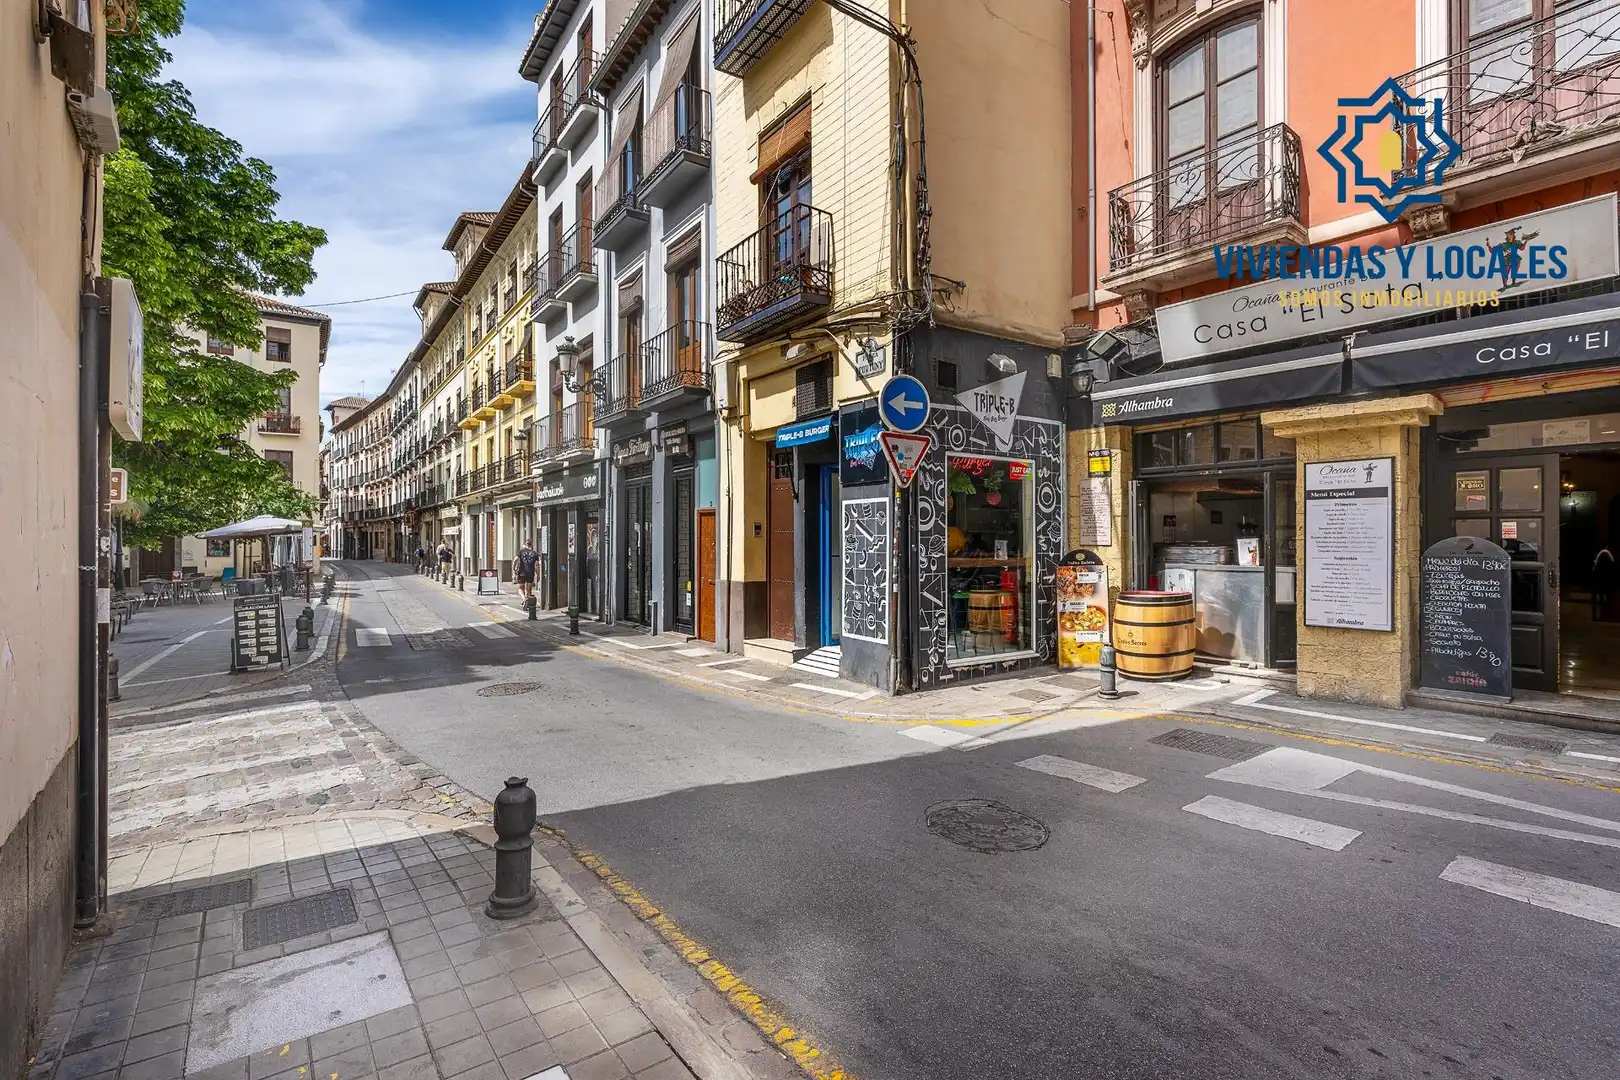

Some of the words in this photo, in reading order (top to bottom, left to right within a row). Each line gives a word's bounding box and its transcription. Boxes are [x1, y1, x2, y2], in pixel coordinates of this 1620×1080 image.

[1194, 315, 1268, 344] Casa
[1476, 342, 1551, 365] Casa
[1118, 395, 1174, 415] Alhambra
[778, 430, 804, 441] TRIPLE-B
[804, 424, 830, 437] BURGER
[1335, 618, 1365, 626] Alhambra
